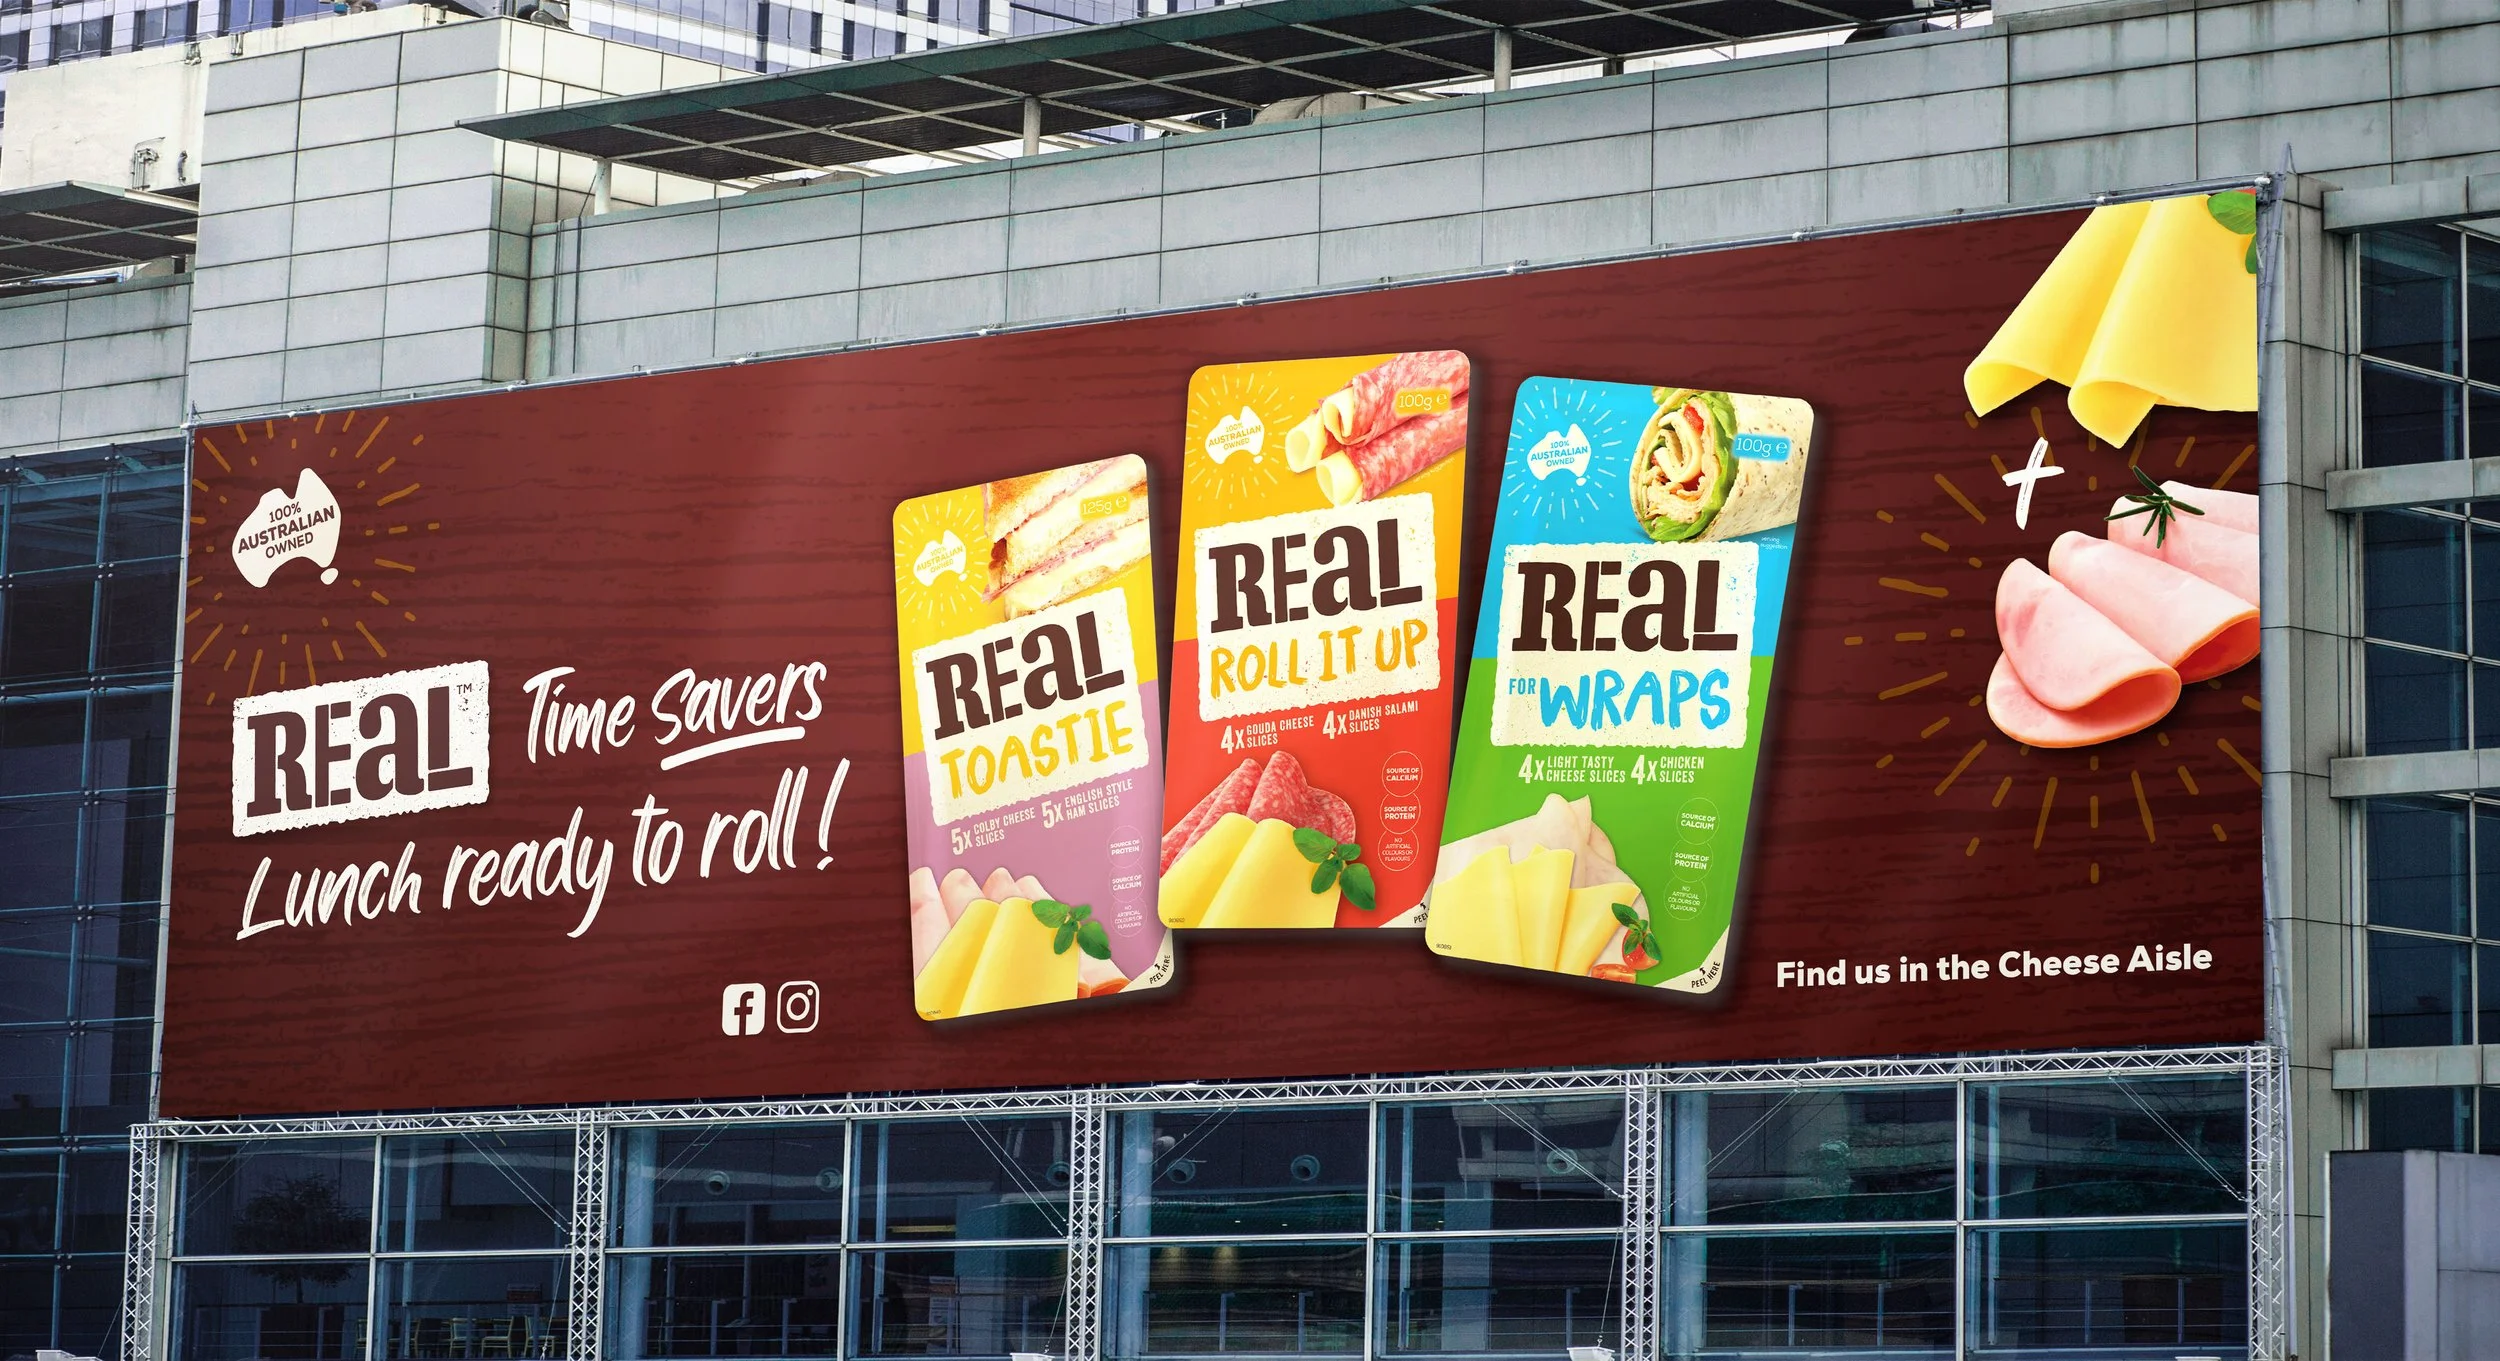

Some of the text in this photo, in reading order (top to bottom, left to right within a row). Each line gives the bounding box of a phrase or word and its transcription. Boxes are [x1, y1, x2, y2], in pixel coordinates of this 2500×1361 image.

[1399, 394, 1433, 411] 100g
[1208, 425, 1262, 448] AUSTRALIAN
[1223, 437, 1250, 450] OWNED
[1550, 440, 1570, 449] 100%
[1530, 445, 1588, 461] AUSTRALIAN
[1735, 437, 1772, 458] 100g
[1546, 457, 1575, 467] OWNED
[268, 501, 302, 524] 100%
[1082, 499, 1113, 515] 125g
[237, 504, 335, 554] AUSTRALIAN
[265, 531, 314, 559] OWNED
[1210, 619, 1428, 700] ROLL IT UP
[1508, 668, 1731, 731] FOR WRAPS
[522, 661, 828, 764] Time Savers
[1349, 705, 1383, 721] DANISH
[1385, 700, 1419, 716] SALAMI
[1246, 721, 1277, 736] GOUDA
[1279, 715, 1315, 731] CHEESE
[1349, 718, 1381, 734] SLICES
[1247, 733, 1279, 748] SLICES
[939, 700, 1134, 800] TOASTIE
[1547, 755, 1577, 769] LIGHT
[1582, 756, 1615, 769] TASTY
[1660, 755, 1705, 769] CHICKEN
[1386, 774, 1419, 782] CALCIUM
[1546, 769, 1626, 783] CHEESE SLICES
[1659, 770, 1695, 784] SLICES
[1064, 786, 1104, 808] ENGLISH
[1106, 778, 1134, 796] STYLE
[1066, 795, 1120, 821] HAM SLICES
[1384, 812, 1416, 820] PROTEIN
[973, 817, 1001, 836] COLBY
[1003, 807, 1036, 827] CHEESE
[1680, 819, 1715, 830] CALCIUM
[1681, 812, 1716, 823] SOURCE OF
[975, 829, 1005, 848] SLICES
[1110, 840, 1132, 849] SOURCE
[1111, 845, 1140, 856] PROTEIN
[1675, 852, 1700, 861] SOURCE
[236, 840, 422, 941] Lunch
[442, 806, 614, 938] ready
[631, 794, 684, 887] to
[1674, 859, 1707, 870] PROTEIN
[1112, 875, 1134, 885] SOURCE
[1112, 880, 1142, 891] CALCIUM
[1149, 954, 1171, 985] PEEL HERE
[1776, 943, 2213, 988] Find us in the Cheese Aisle
[1691, 961, 1721, 989] PEEL HERE
